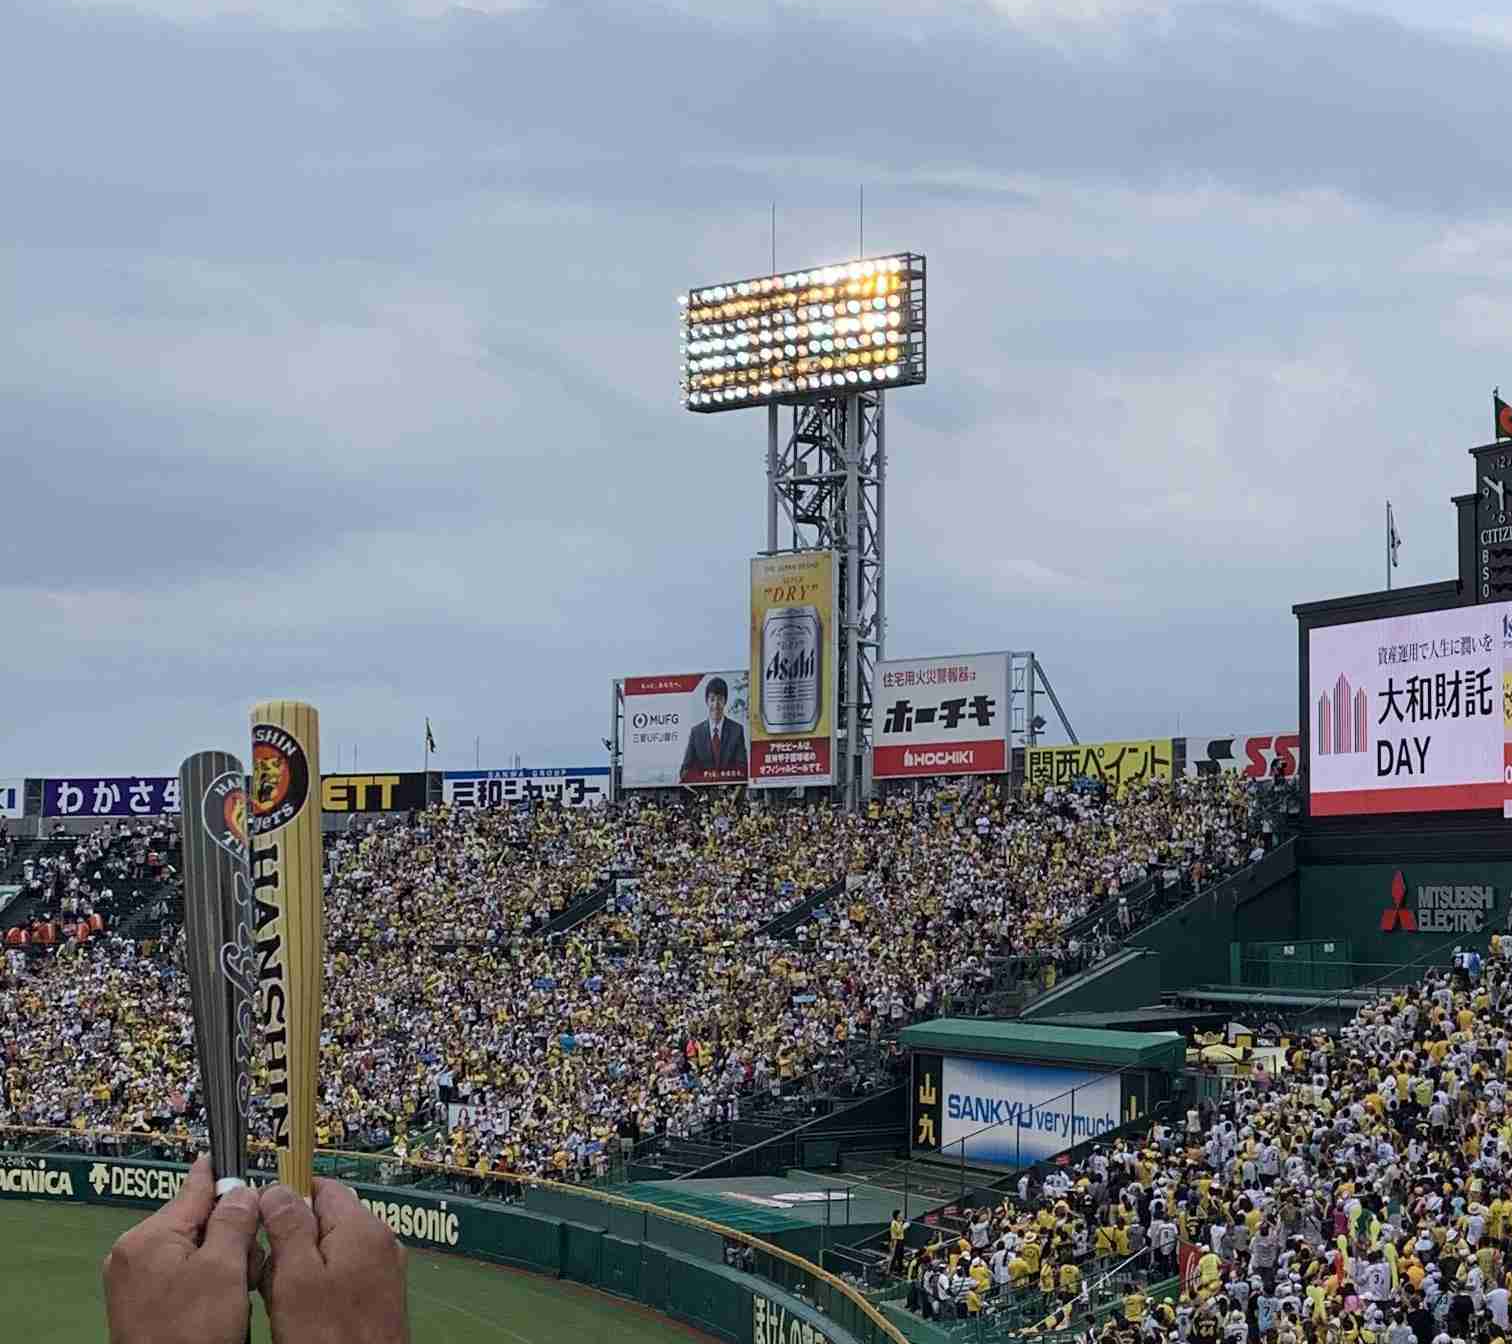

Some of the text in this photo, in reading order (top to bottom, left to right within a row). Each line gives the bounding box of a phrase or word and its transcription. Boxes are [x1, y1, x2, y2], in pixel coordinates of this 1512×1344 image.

[766, 648, 815, 681] Asahi
[1378, 633, 1494, 666] 資産運用で人生に潤いを
[1377, 666, 1494, 726] 大和財託
[649, 713, 680, 726] MUFG
[882, 694, 996, 734] ホーチキ
[914, 750, 975, 766] HOCHIKI
[1029, 744, 1169, 786] 関西ペイント
[1377, 736, 1431, 777] DAY
[1417, 885, 1494, 910] MITSUBISHI
[1417, 908, 1485, 932] ELECTRIC
[947, 1092, 1115, 1138] SANKYU very much
